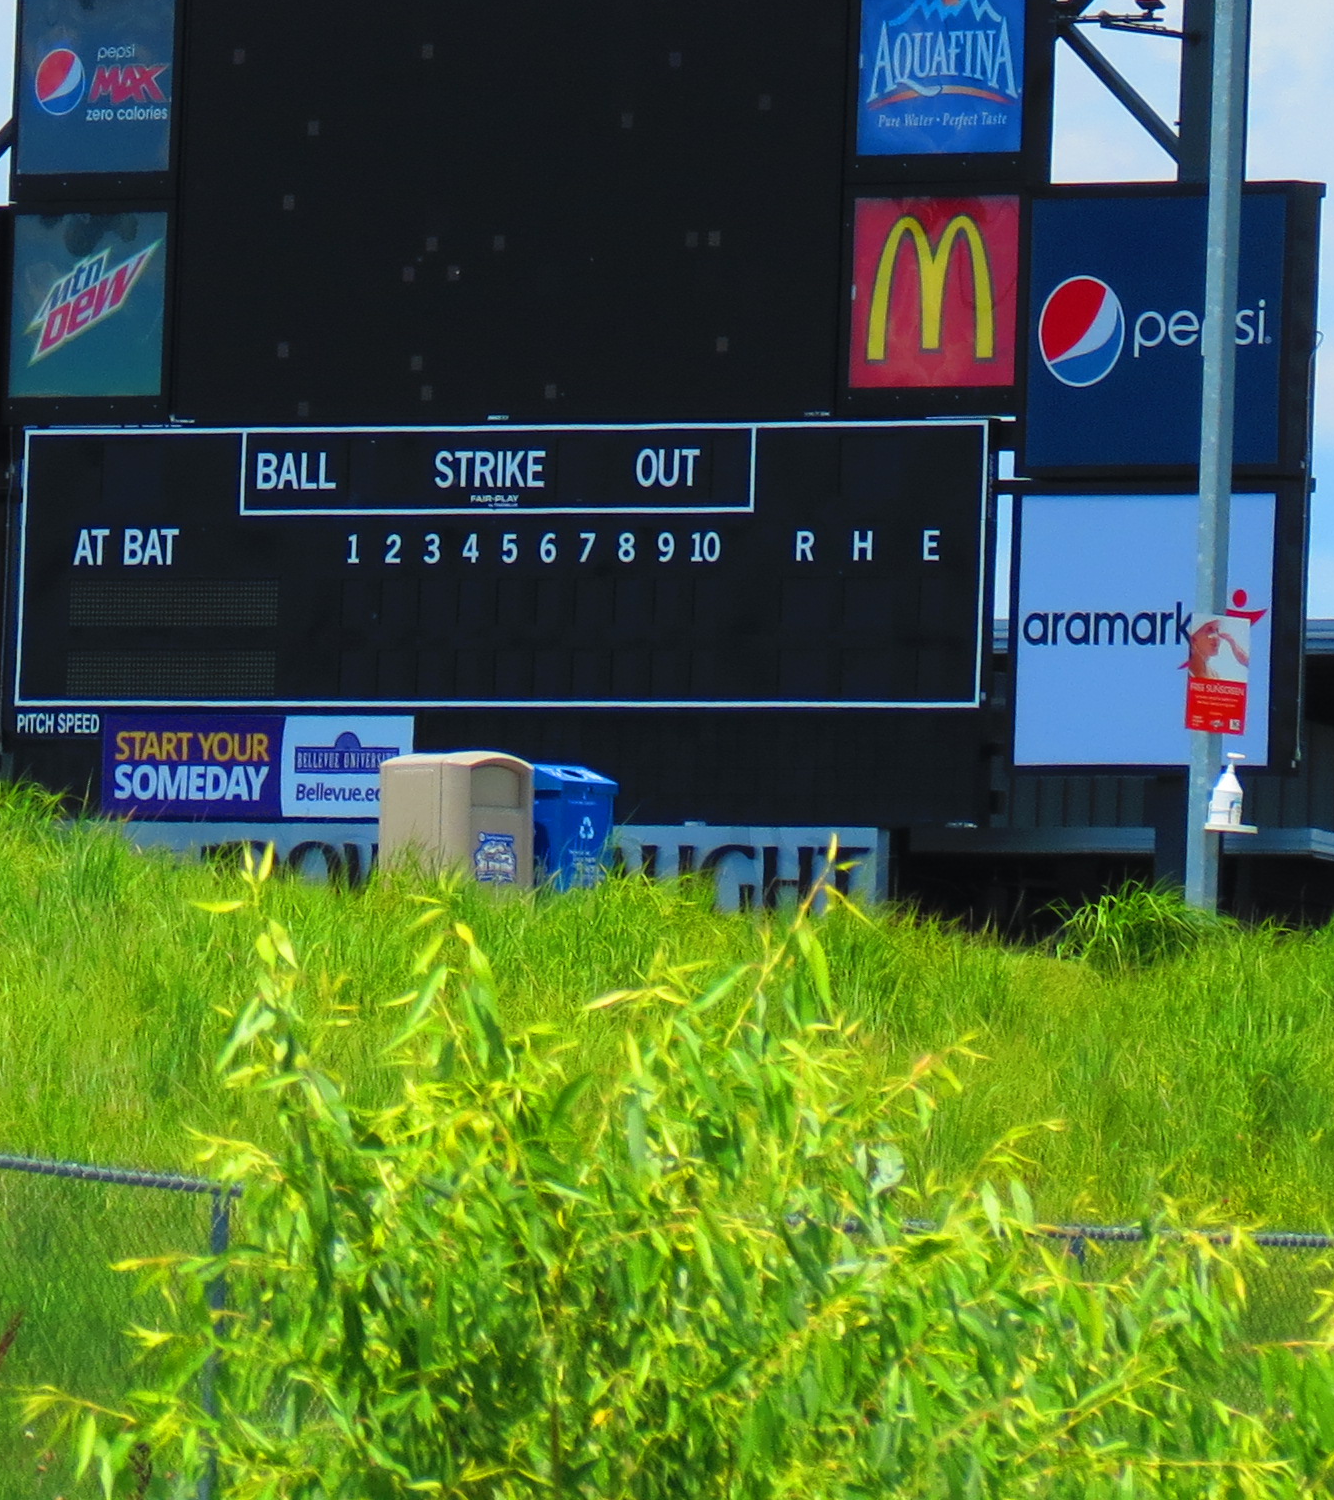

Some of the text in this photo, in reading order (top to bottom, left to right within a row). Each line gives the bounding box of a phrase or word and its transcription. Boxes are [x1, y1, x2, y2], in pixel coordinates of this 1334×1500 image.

[97, 44, 135, 61] pepsi
[868, 17, 1018, 103] AQUAFINA
[87, 63, 169, 105] MAX
[86, 105, 168, 121] zero calories
[878, 111, 1007, 130] Pure Water Perfect Taste
[1134, 299, 1266, 358] pesi
[255, 448, 701, 490] BALL STRIKE OUT
[73, 528, 180, 566] AT BAT
[346, 531, 721, 564] 1 2 3 4 5 6 7 8 9 10
[795, 529, 940, 562] R H E
[1023, 601, 1192, 646] aramark
[16, 713, 100, 735] PITCH SPEED
[115, 731, 270, 762] START YOUR
[297, 752, 396, 769] BELLEVUE UNIVERS
[113, 764, 270, 801] SOMEDAY
[296, 782, 380, 802] Bellevue.e
